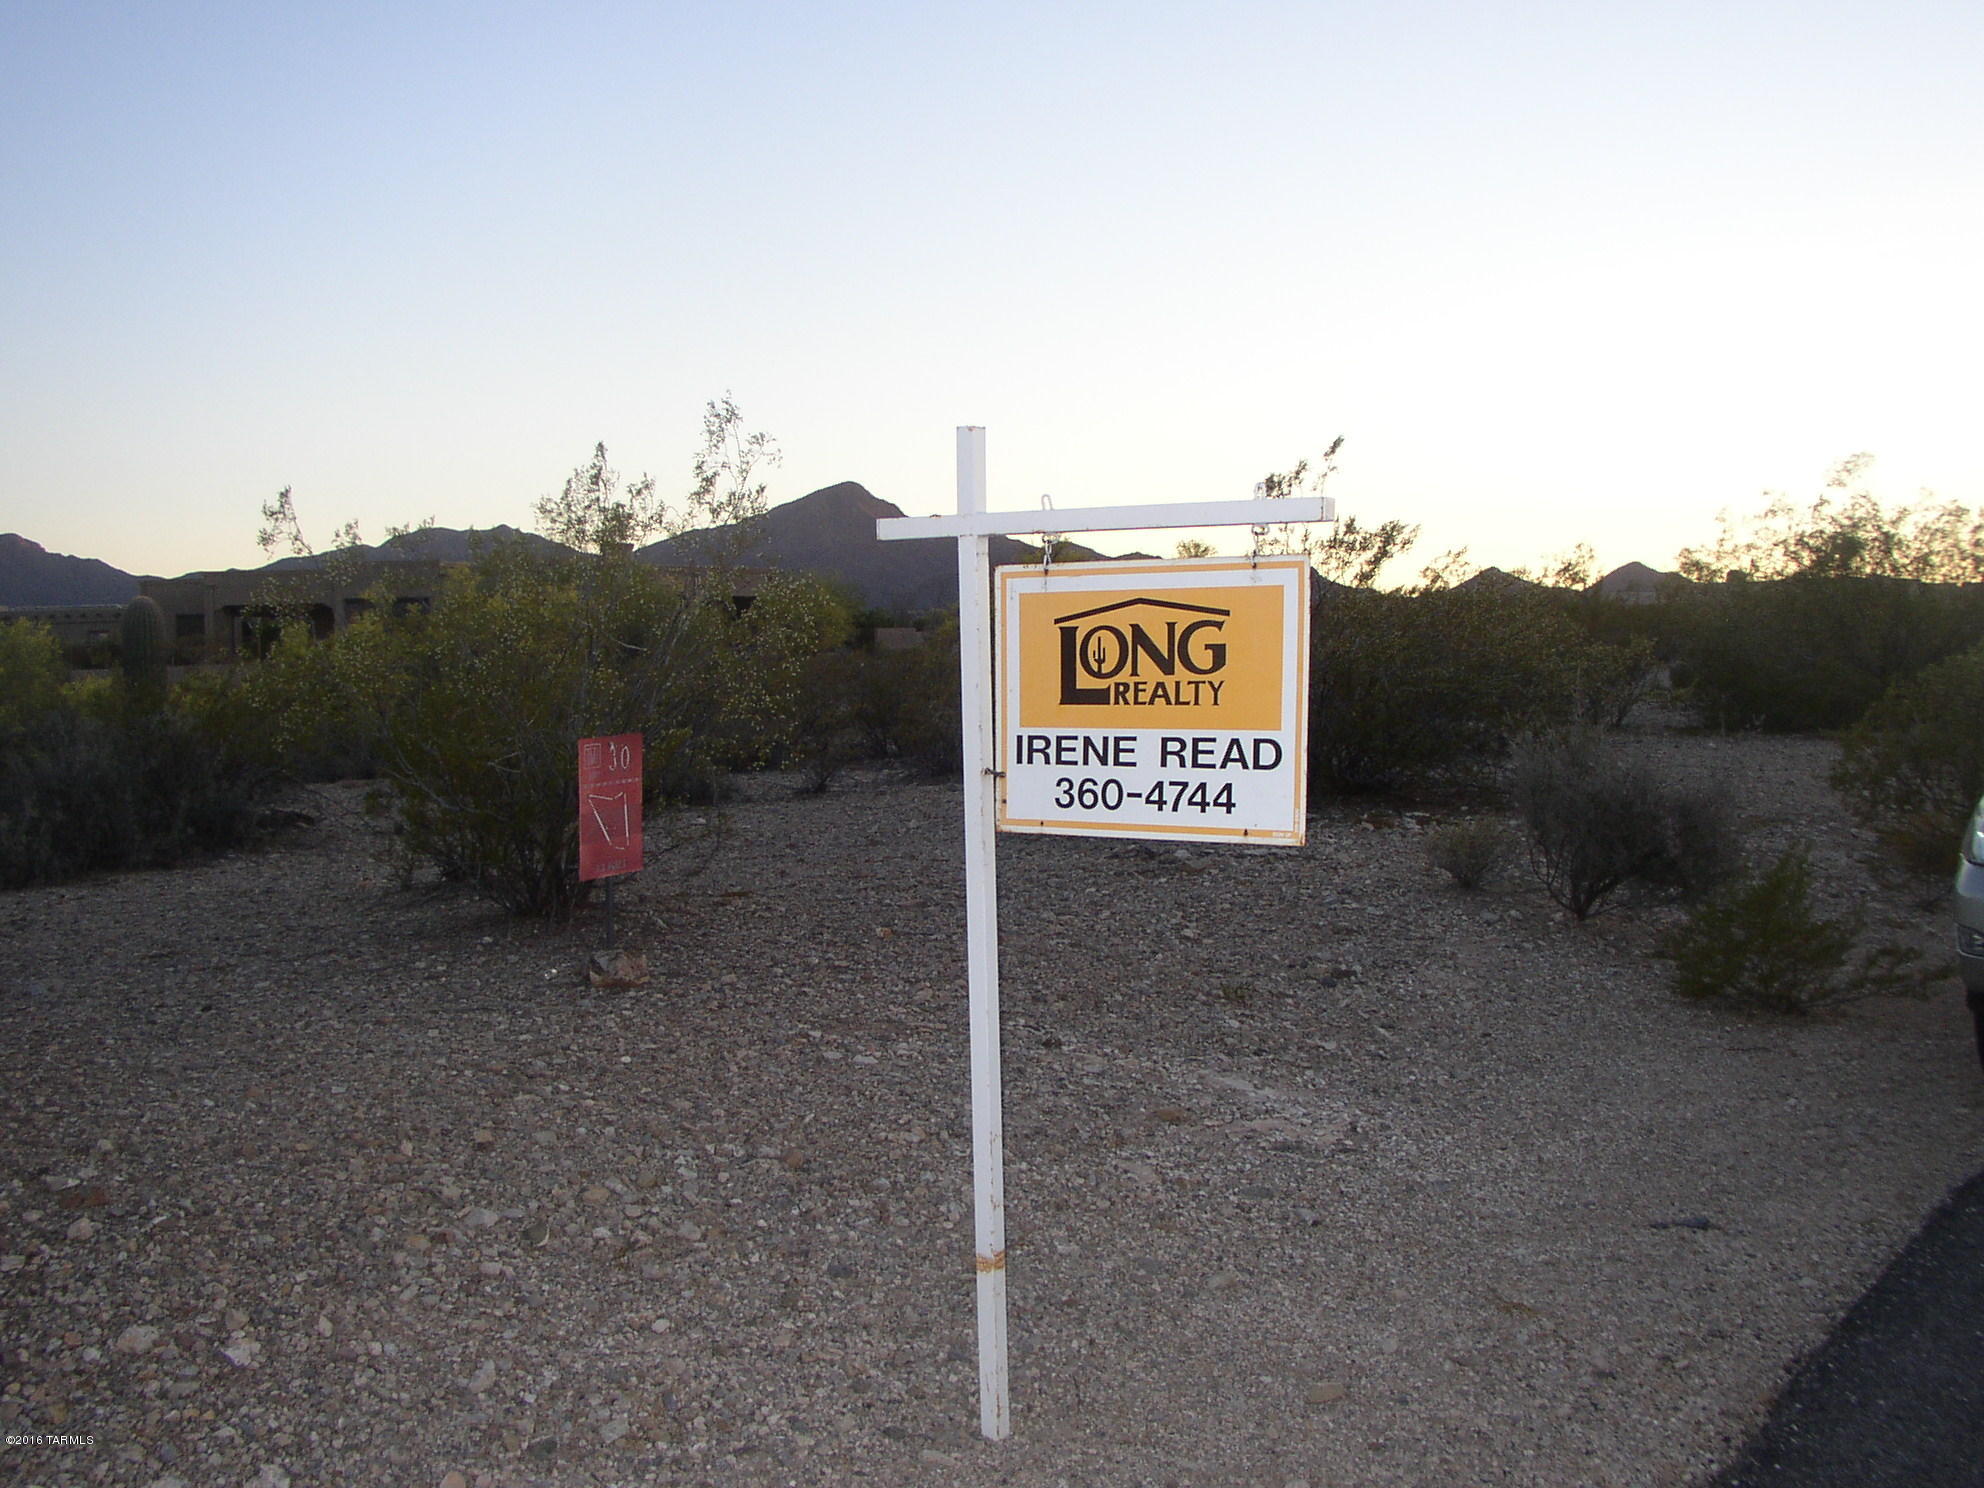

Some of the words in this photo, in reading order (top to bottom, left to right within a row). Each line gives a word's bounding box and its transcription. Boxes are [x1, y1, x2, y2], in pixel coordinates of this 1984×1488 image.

[1058, 619, 1227, 705] LONG
[1113, 680, 1225, 706] REALTY
[1016, 734, 1138, 767] IRENE
[1160, 736, 1283, 770] READ
[1054, 777, 1236, 814] 360-4744
